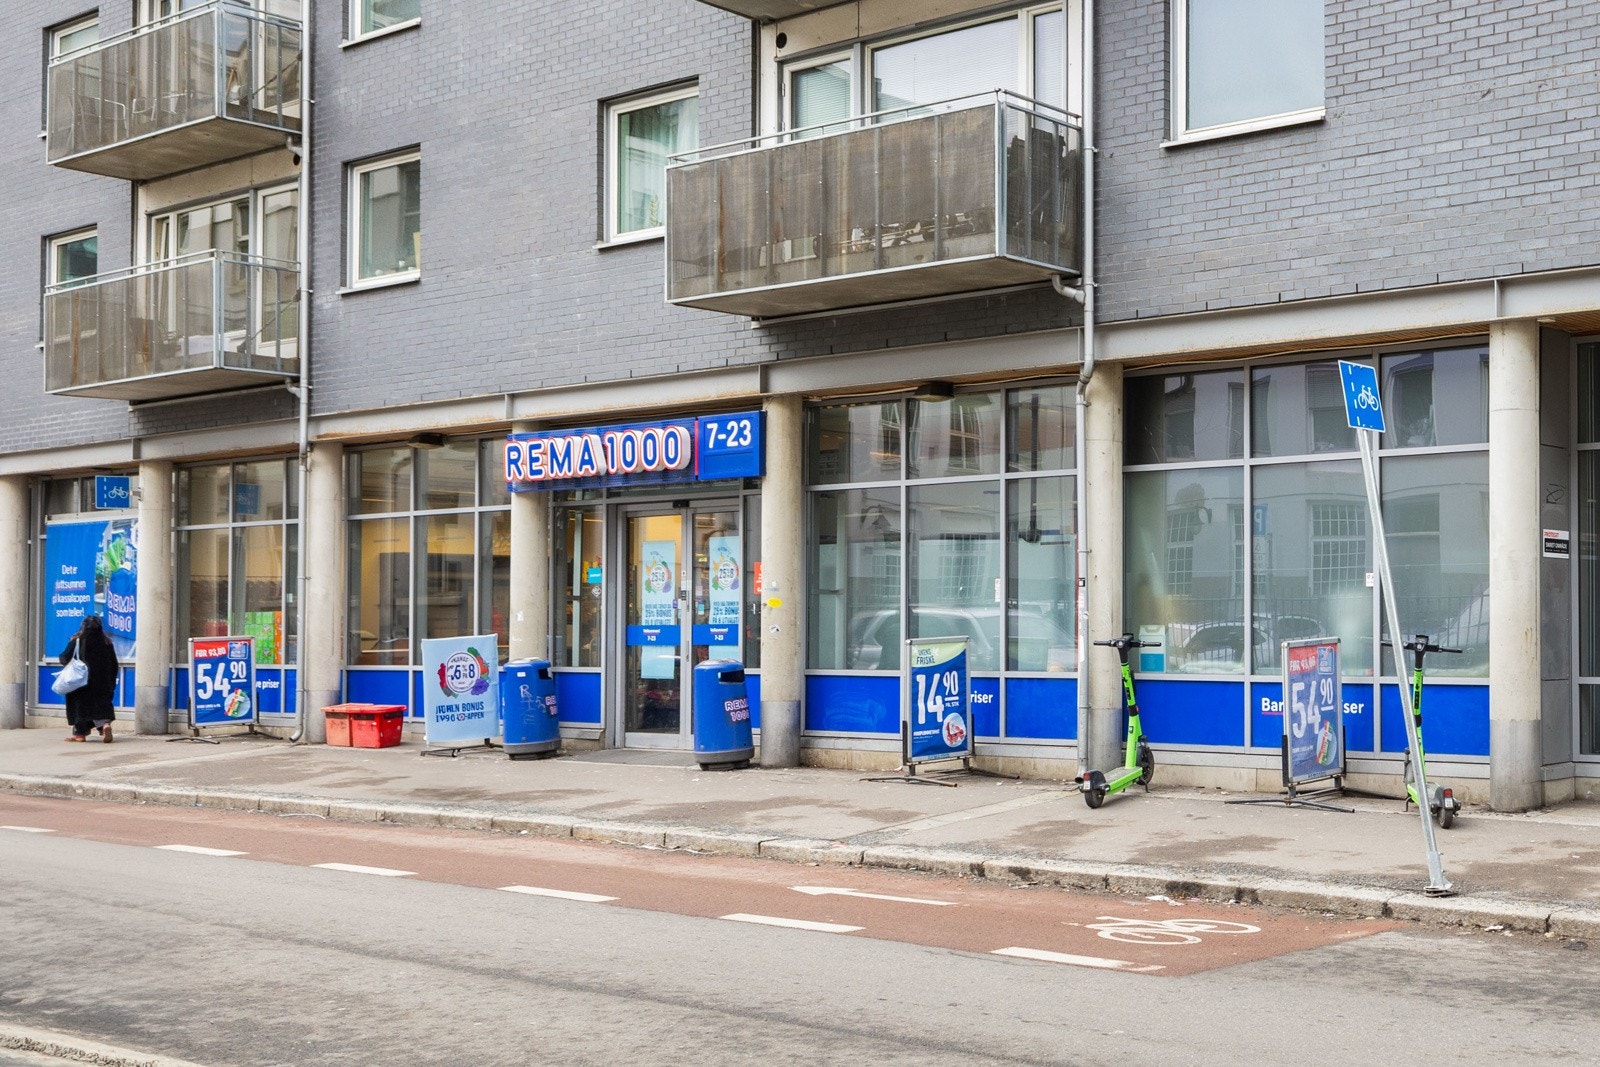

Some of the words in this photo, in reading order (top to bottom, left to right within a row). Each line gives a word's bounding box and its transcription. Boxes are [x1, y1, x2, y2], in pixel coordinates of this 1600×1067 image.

[706, 419, 752, 449] 7-23
[504, 433, 602, 482] REMA
[603, 425, 686, 475] 1000
[197, 662, 231, 700] 54
[230, 661, 247, 679] 90
[262, 679, 280, 690] priser
[724, 698, 749, 712] REM
[916, 673, 945, 725] 14
[943, 670, 959, 696] 90
[970, 690, 993, 704] riser
[1261, 697, 1283, 712] Bar
[1343, 699, 1364, 714] ser
[1291, 680, 1322, 739] 54
[1320, 678, 1334, 705] 90
